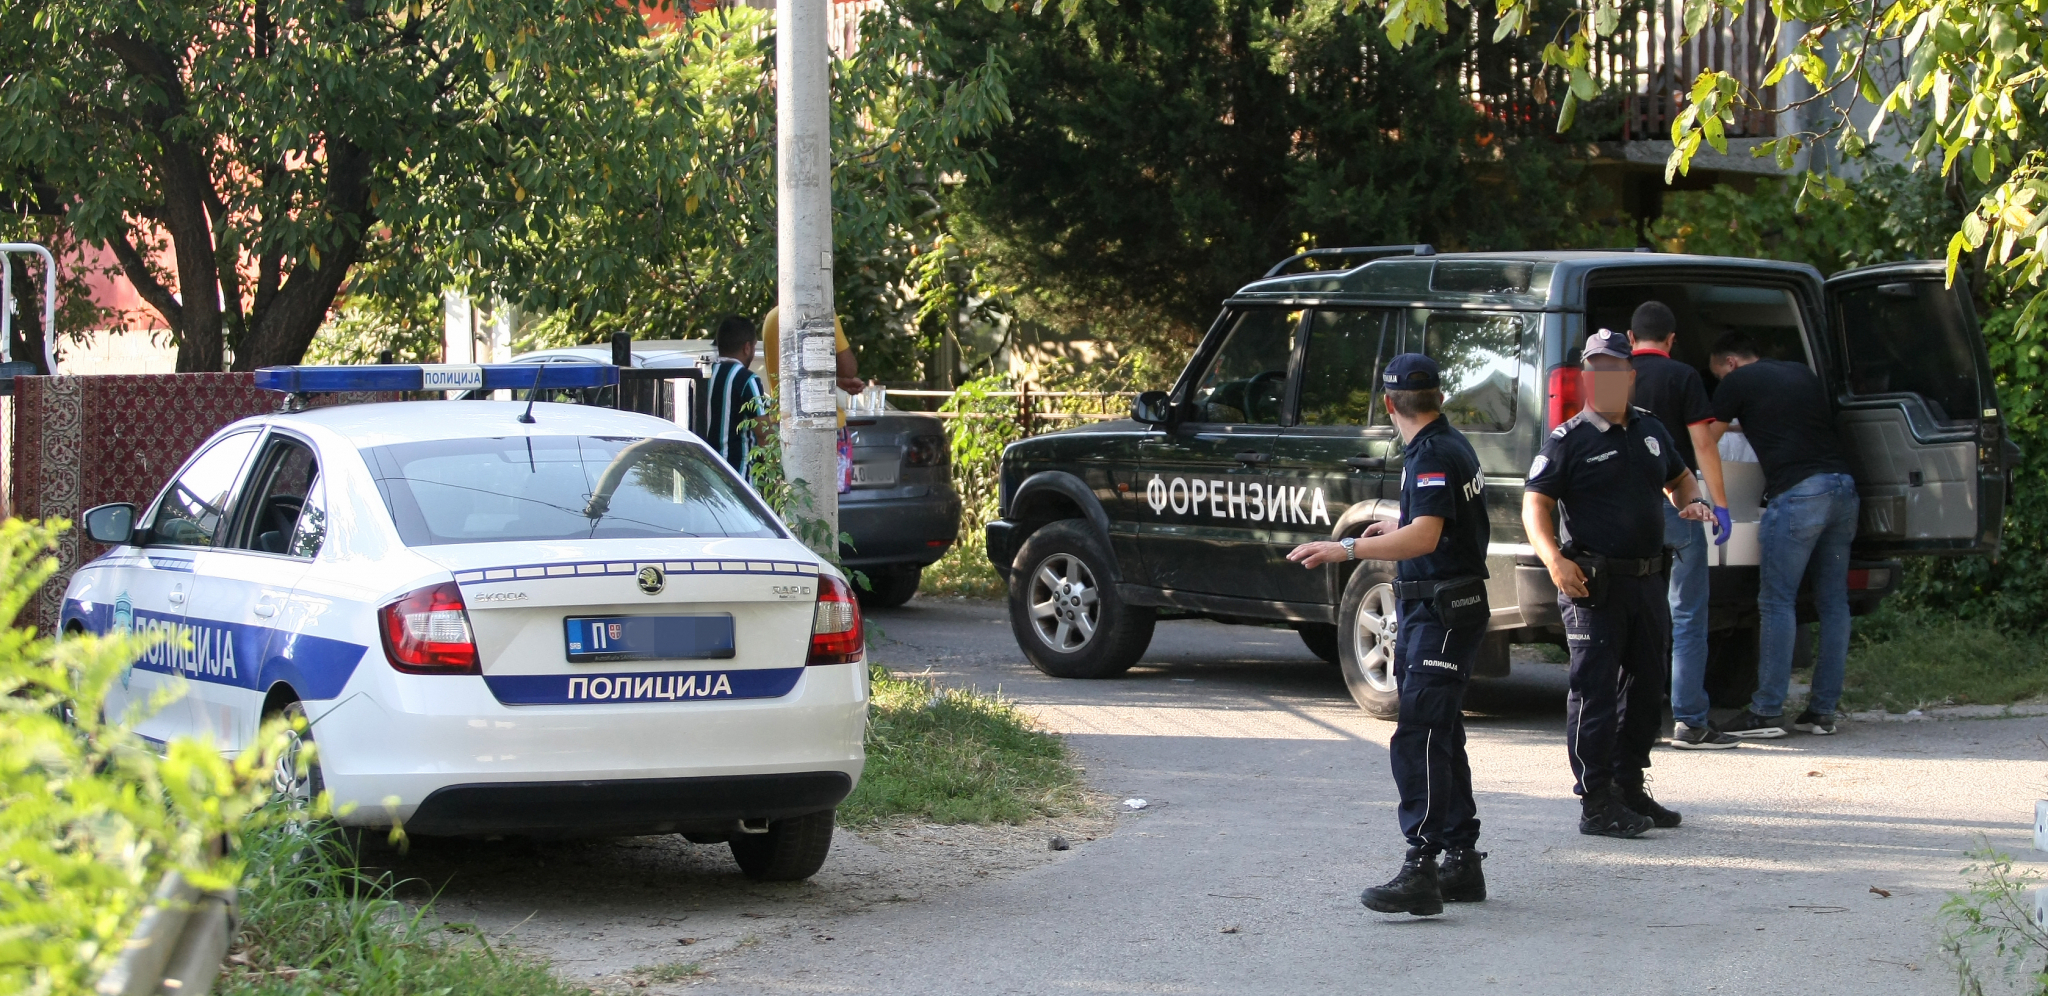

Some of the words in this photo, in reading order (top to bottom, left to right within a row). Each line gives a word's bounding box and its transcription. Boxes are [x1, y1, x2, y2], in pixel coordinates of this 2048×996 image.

[425, 372, 481, 386] ПОЛИЦИЈА
[1147, 474, 1331, 526] ФОРЕНЗИКА
[772, 586, 811, 595] RAPID
[1451, 595, 1481, 608] ПОЛИЦИЈА
[135, 616, 237, 679] ПОЛИЦИЈА
[1423, 659, 1458, 671] ПОЛИЦИЈА
[568, 674, 733, 700] ПОЛИЦИЈА
